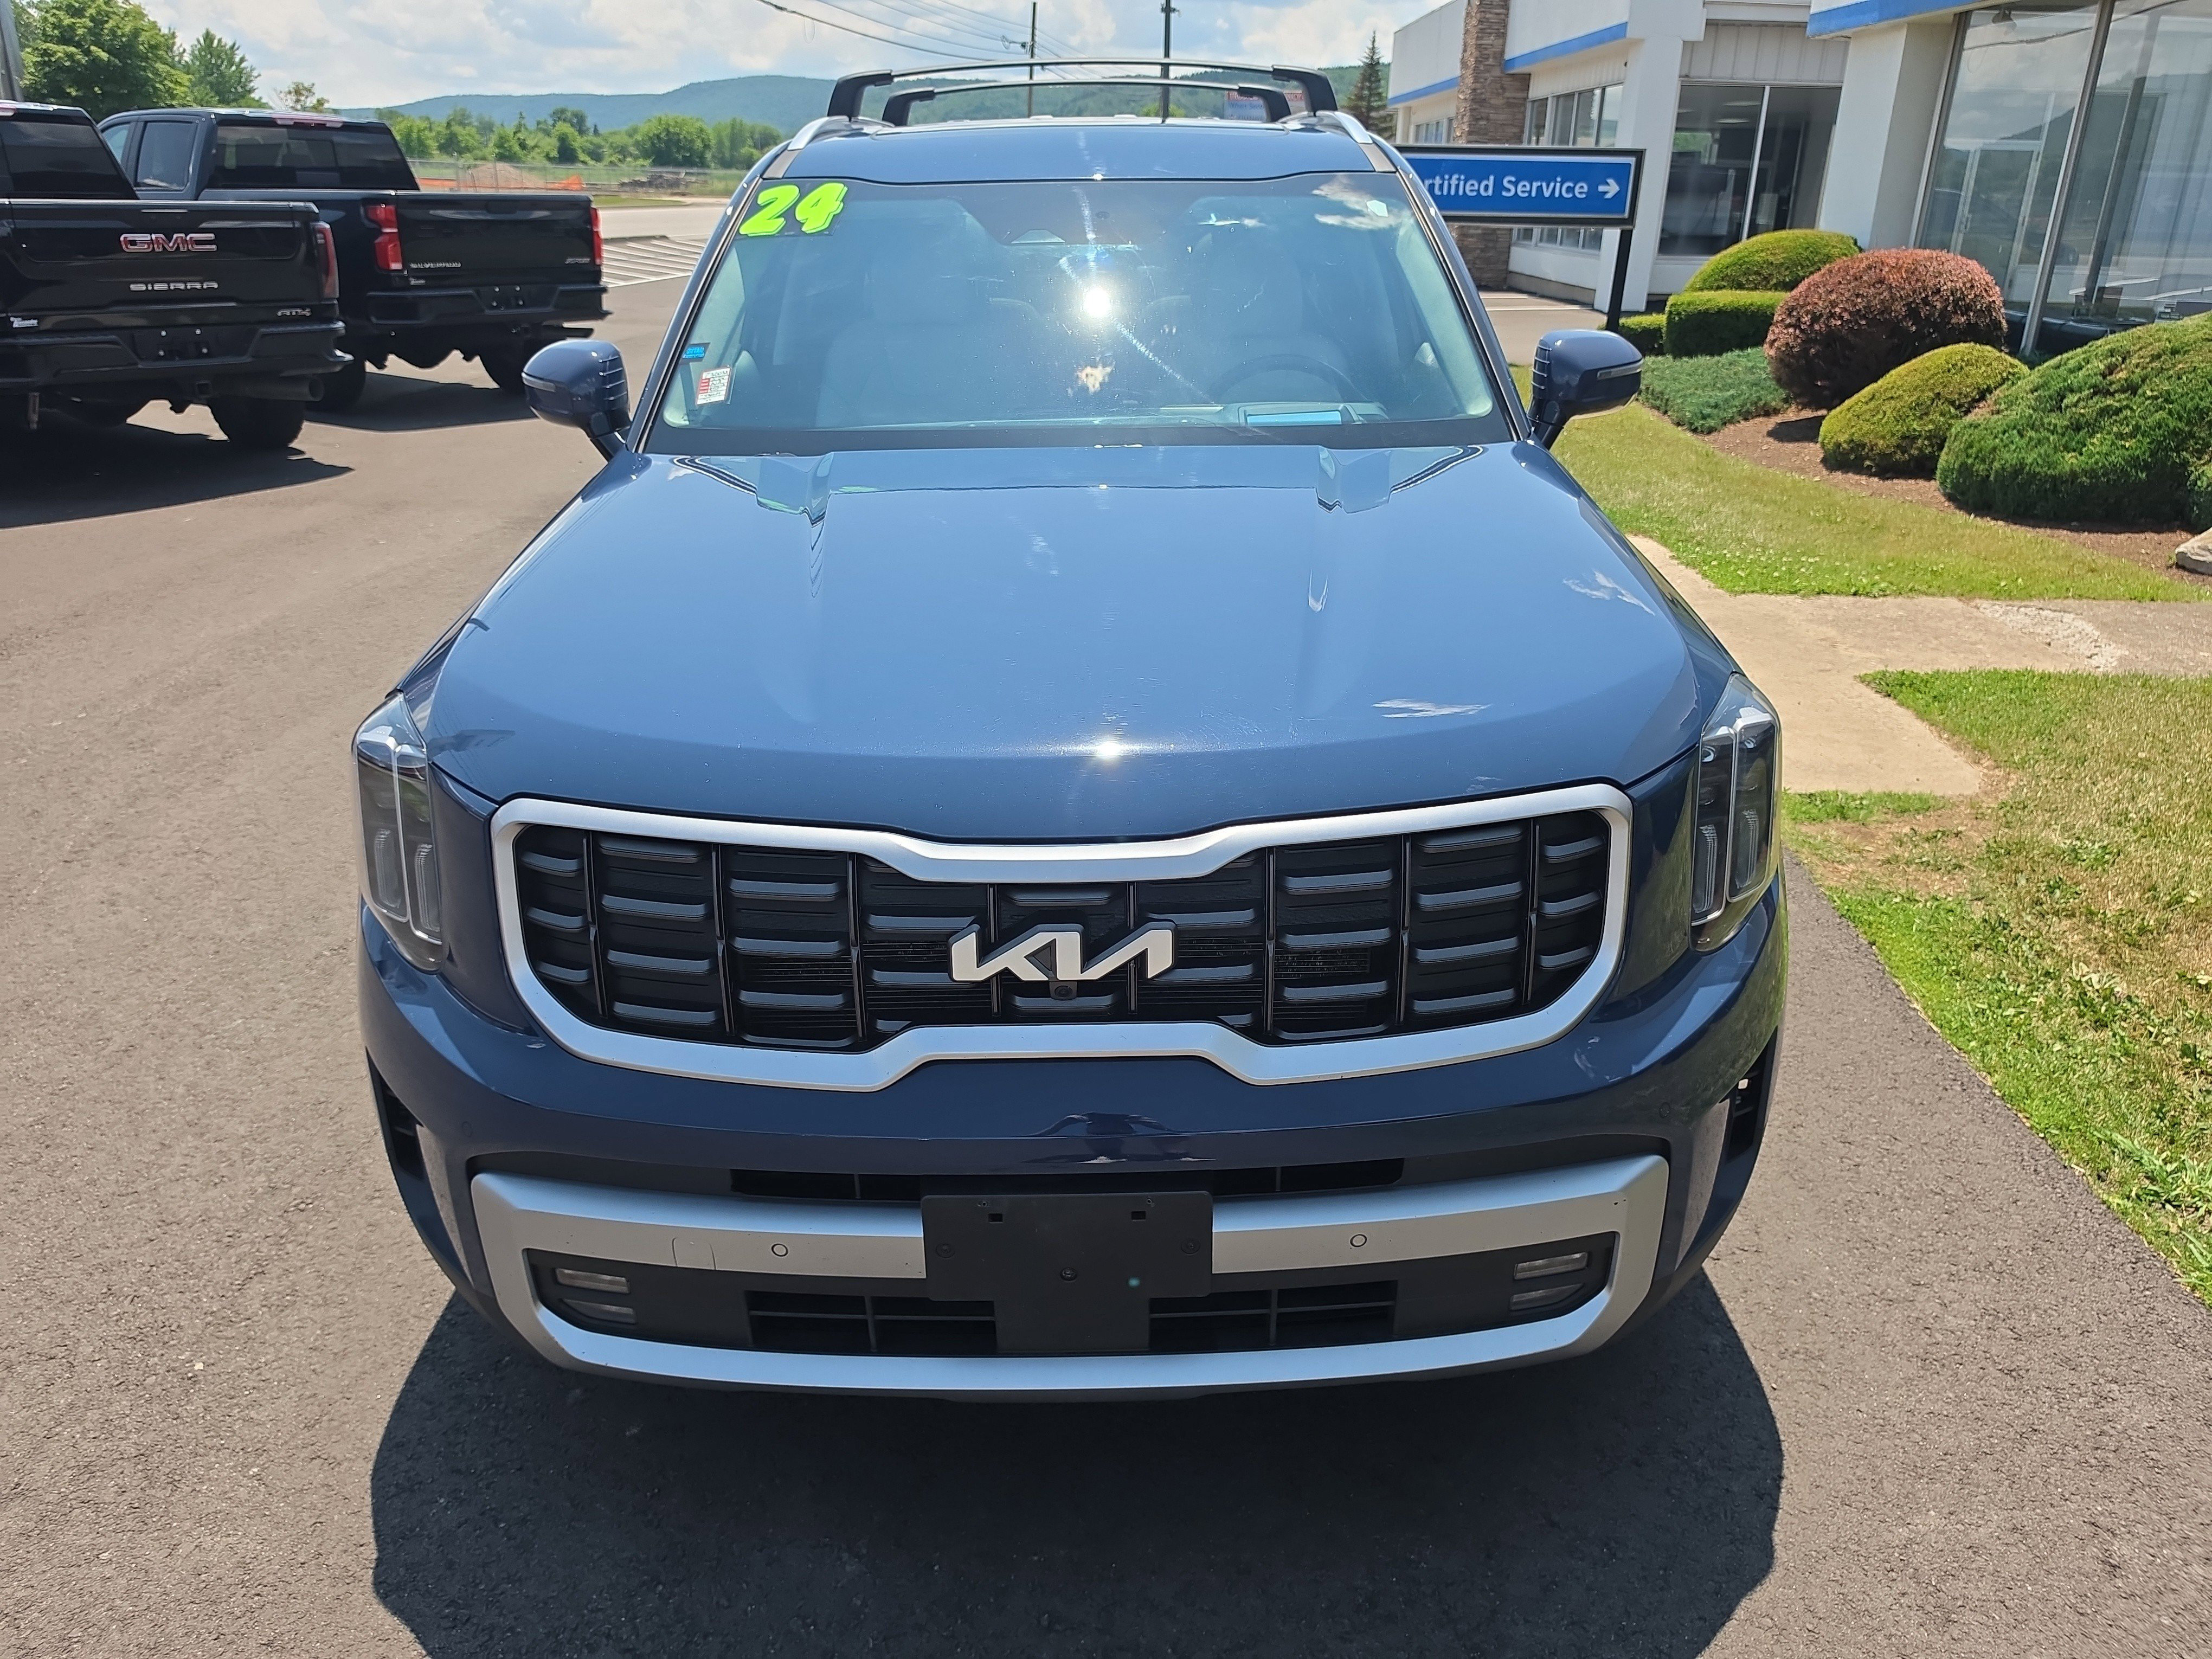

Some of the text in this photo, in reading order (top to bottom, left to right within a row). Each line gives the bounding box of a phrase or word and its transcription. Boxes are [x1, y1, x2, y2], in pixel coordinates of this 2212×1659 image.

[1423, 174, 1589, 199] rtified Service
[740, 182, 849, 237] 24
[120, 233, 217, 252] GMC
[130, 281, 218, 291] SIERRA
[951, 929, 1173, 981] KIA
